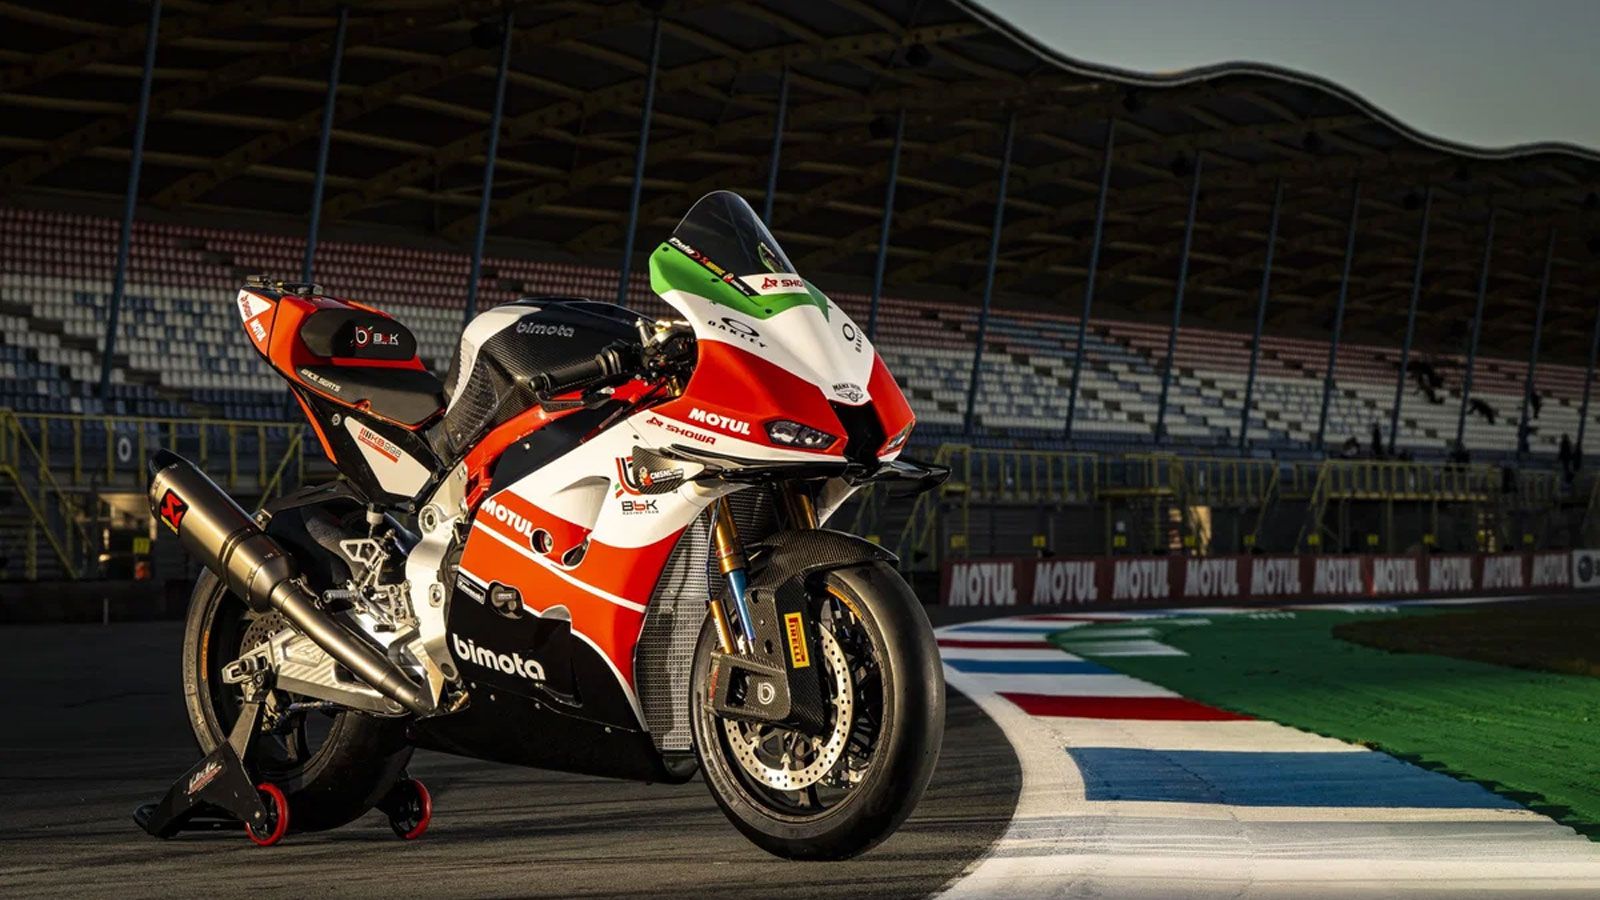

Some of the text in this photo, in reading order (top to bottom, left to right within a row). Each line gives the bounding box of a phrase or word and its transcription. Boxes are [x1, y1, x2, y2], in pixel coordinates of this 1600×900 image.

[516, 321, 575, 338] bimota
[707, 319, 768, 349] OAKLEY
[666, 423, 716, 445] SHOWA
[688, 407, 752, 435] MOTUL
[480, 499, 534, 537] MOTUL
[950, 563, 1018, 606] MOTUL
[1033, 561, 1098, 604] MOTUL
[1113, 560, 1171, 599] MOTUL
[1184, 559, 1239, 597] MOTUL
[1251, 558, 1302, 595] MOTUL
[1313, 557, 1363, 594] MOTUL
[1373, 557, 1419, 594] MOTUL
[452, 633, 547, 681] bimota
[788, 617, 806, 662] PIRELLI
